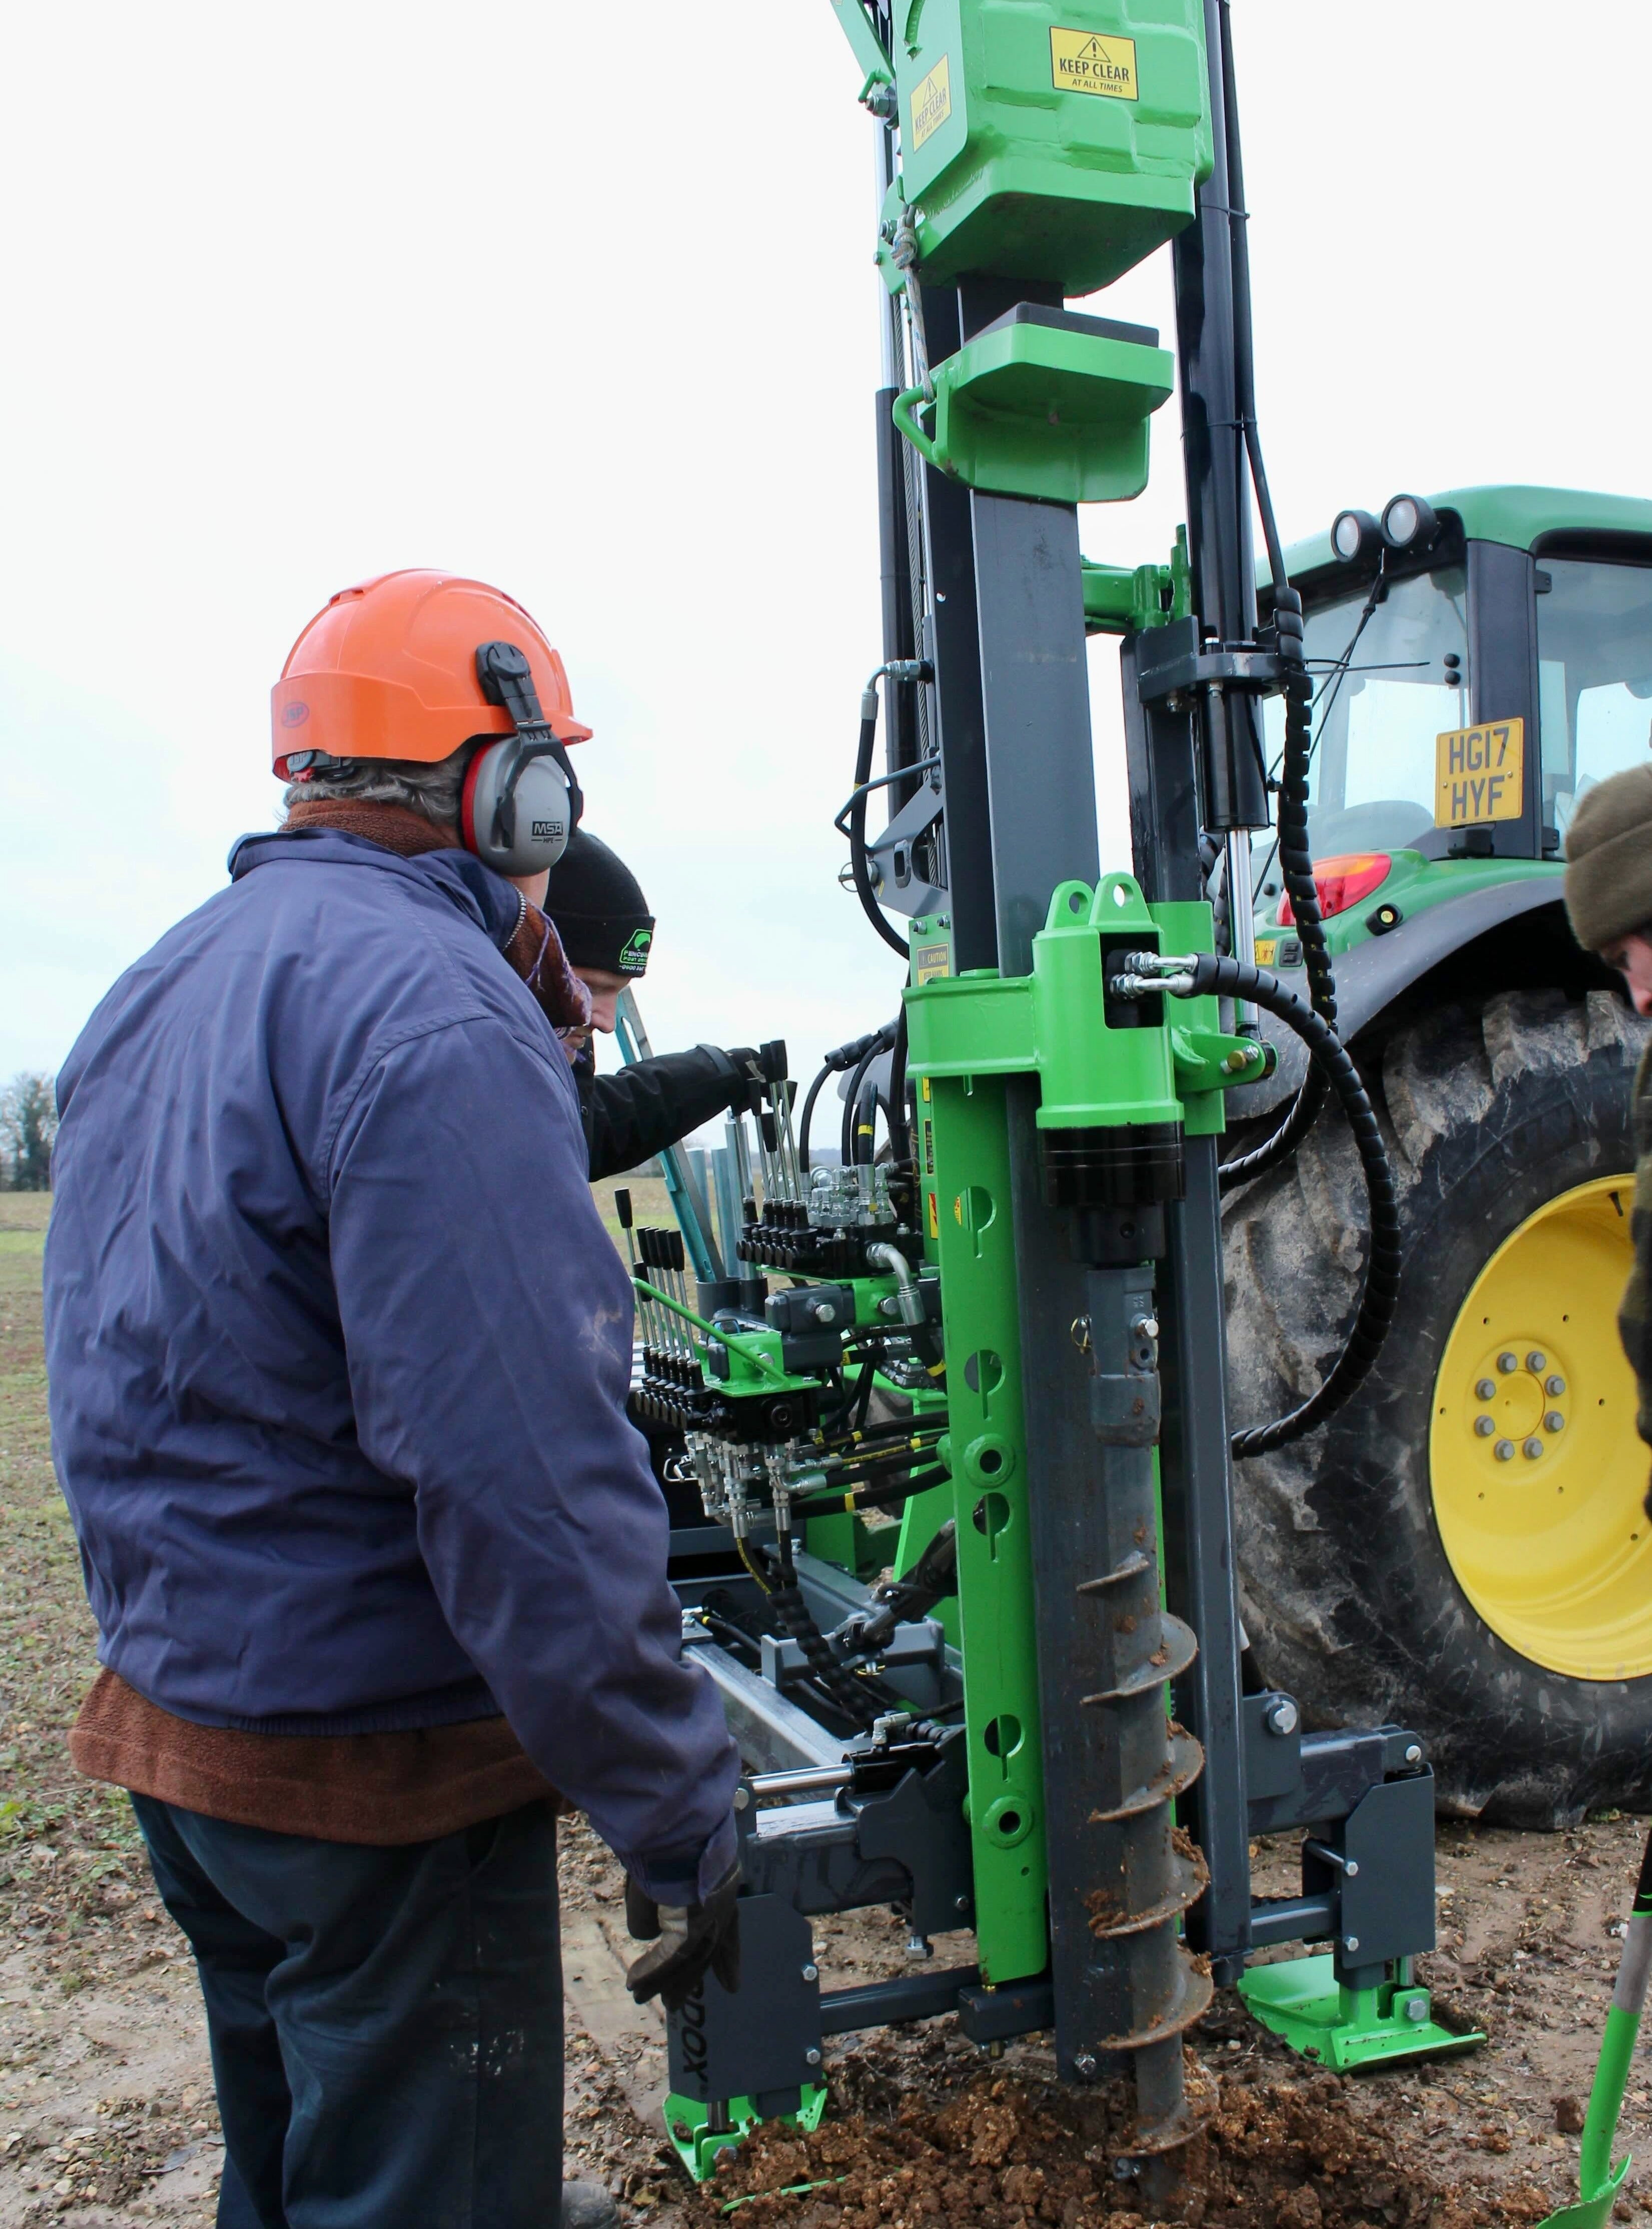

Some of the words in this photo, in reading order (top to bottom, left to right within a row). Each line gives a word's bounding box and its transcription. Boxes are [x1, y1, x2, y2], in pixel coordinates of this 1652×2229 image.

[1060, 58, 1089, 75] KEEP
[1093, 63, 1129, 81] CLEAR
[1083, 81, 1097, 89] ALL
[1100, 83, 1123, 93] TIMES
[915, 107, 929, 131] KEEP
[930, 88, 947, 116] CLEAR
[921, 129, 926, 138] AT
[933, 110, 945, 126] TIMES
[1449, 726, 1509, 775] HG17
[1451, 775, 1505, 820] HYF
[534, 823, 562, 834] MSA
[928, 951, 947, 964] CAUTION
